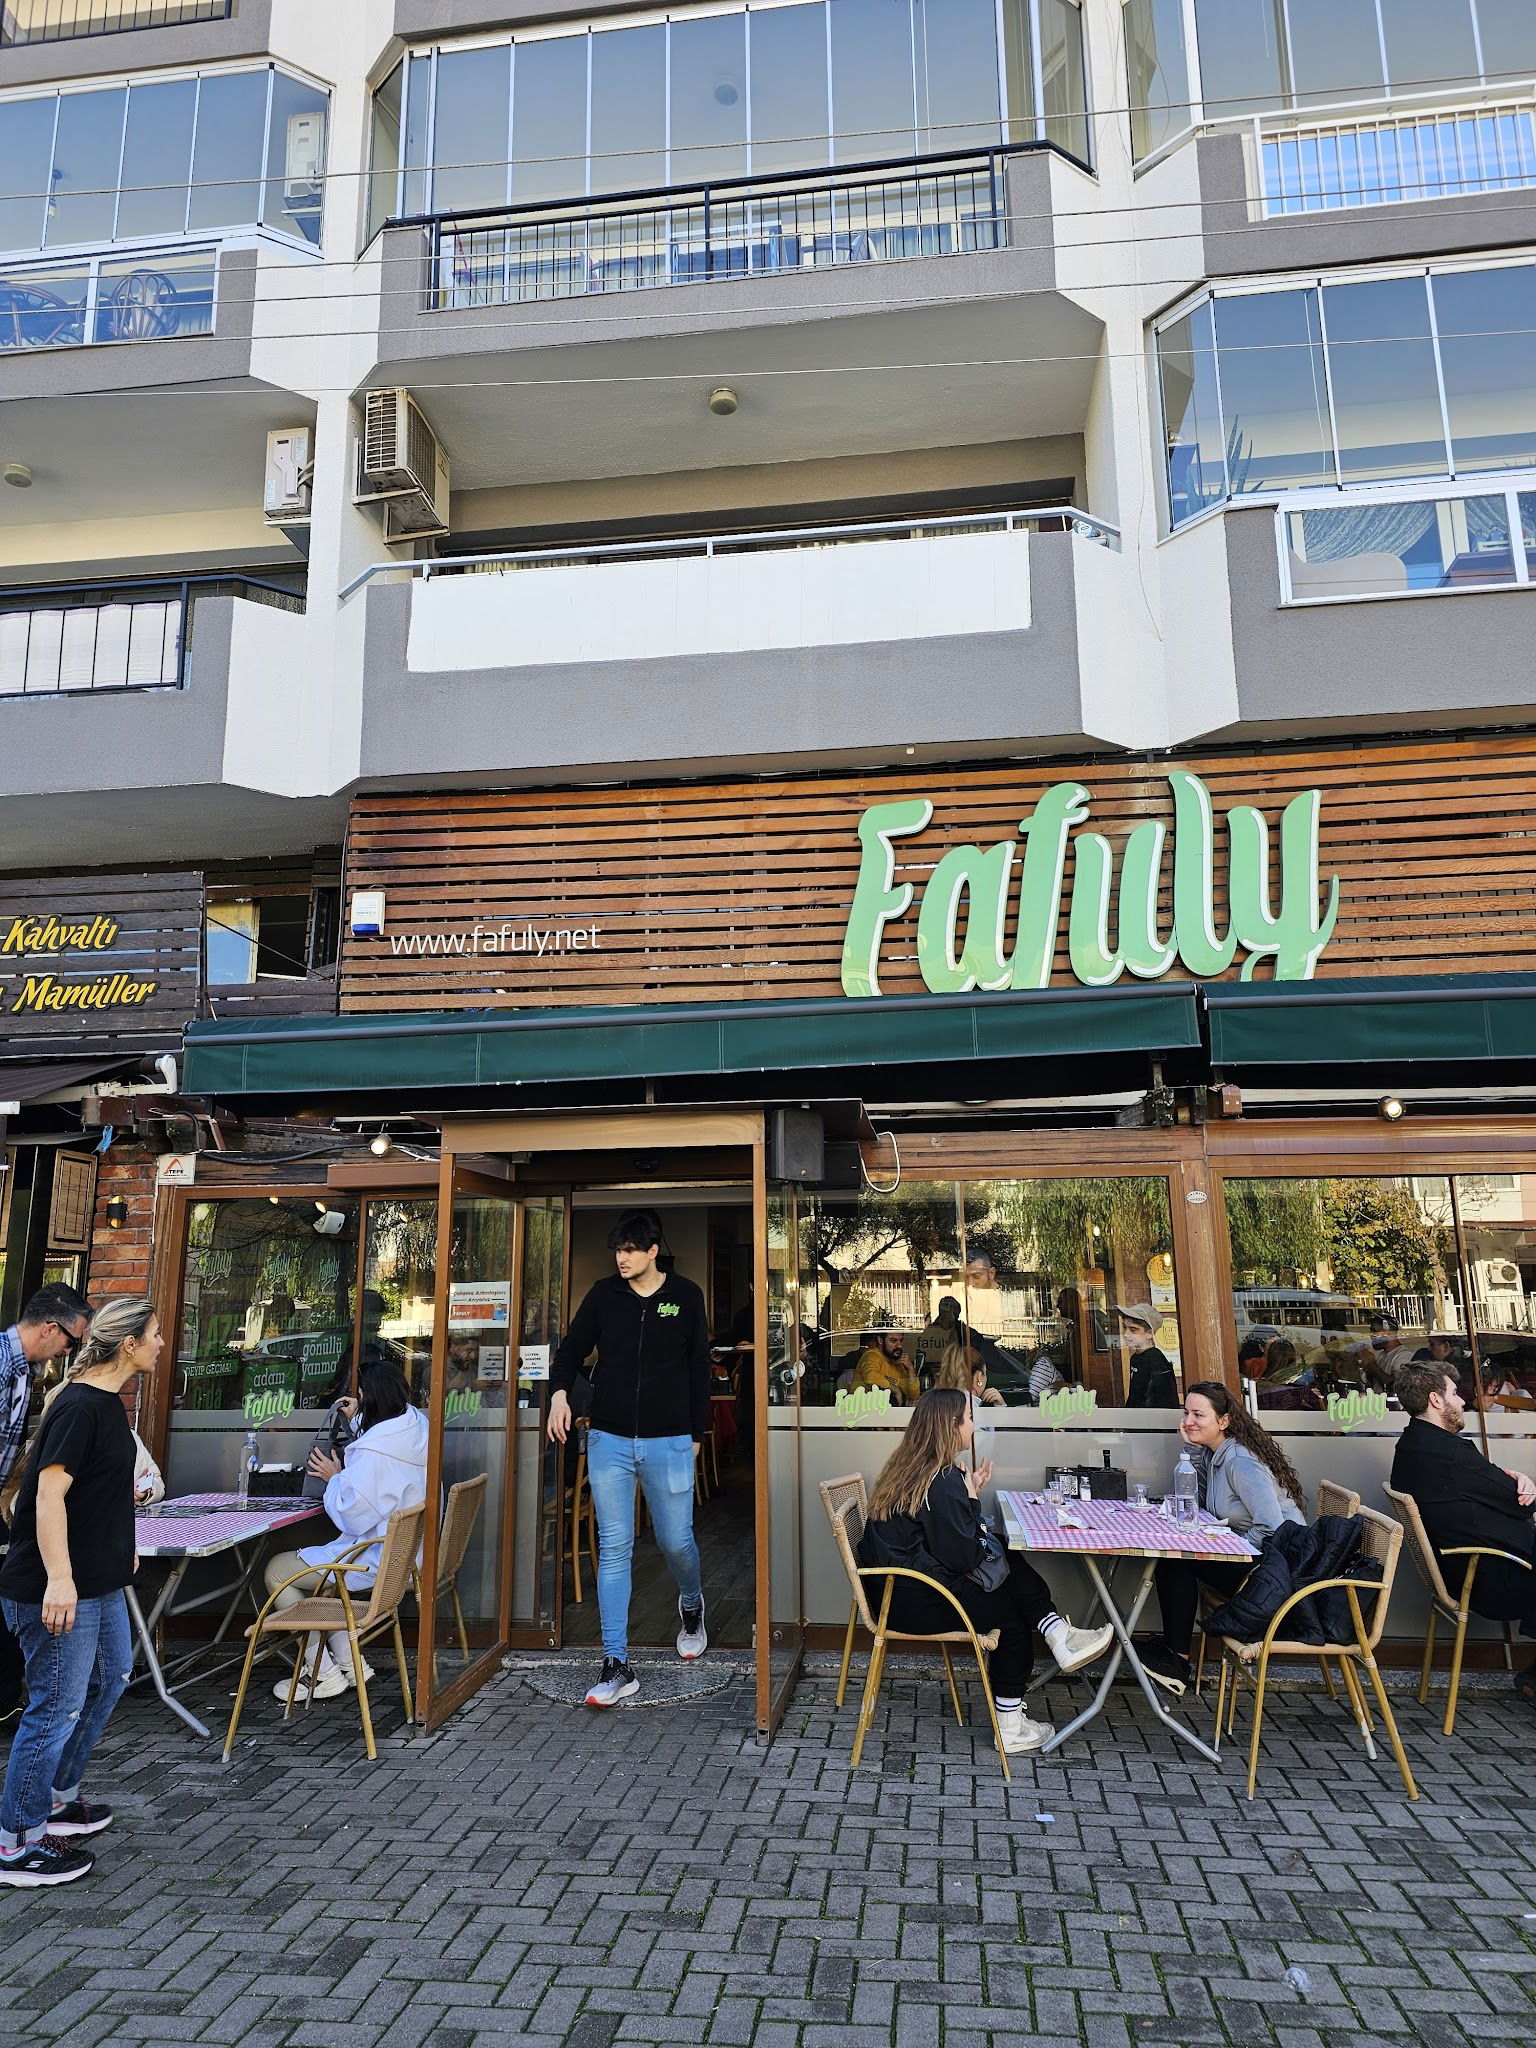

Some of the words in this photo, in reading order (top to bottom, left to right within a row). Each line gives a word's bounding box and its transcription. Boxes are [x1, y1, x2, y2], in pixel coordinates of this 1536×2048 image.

[841, 771, 1339, 999] Fafuly
[2, 915, 119, 952] Kahvaltı
[390, 923, 602, 957] www.fafuly.net
[11, 974, 156, 1012] Mamüller
[302, 1336, 342, 1361] gönüllü
[253, 1367, 285, 1387] adam
[243, 1388, 296, 1422] Fafuly
[444, 1386, 482, 1420] fuly
[836, 1384, 892, 1418] Fafuly
[1039, 1385, 1098, 1418] Fafuly
[1327, 1388, 1389, 1424] Fafuly
